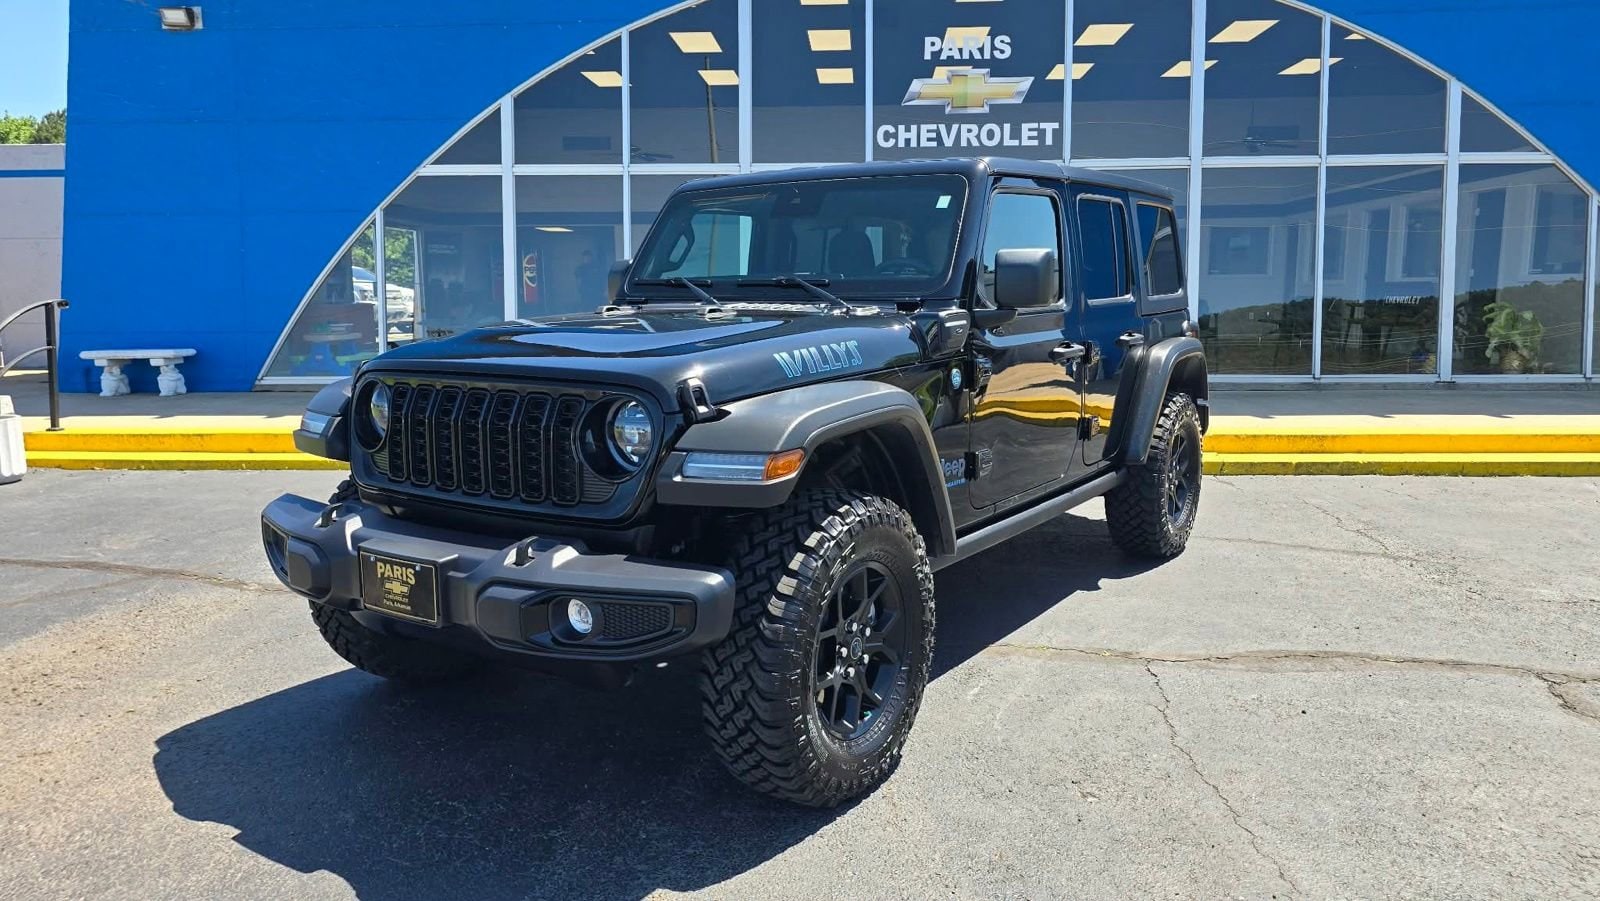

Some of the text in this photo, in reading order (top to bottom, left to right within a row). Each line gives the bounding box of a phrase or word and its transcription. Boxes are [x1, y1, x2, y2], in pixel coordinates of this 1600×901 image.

[924, 35, 1012, 60] PARIS
[876, 122, 1059, 148] CHEVROLET
[1384, 295, 1421, 304] CHEVROLET
[773, 340, 863, 378] WILLYS
[376, 561, 416, 585] PARIS
